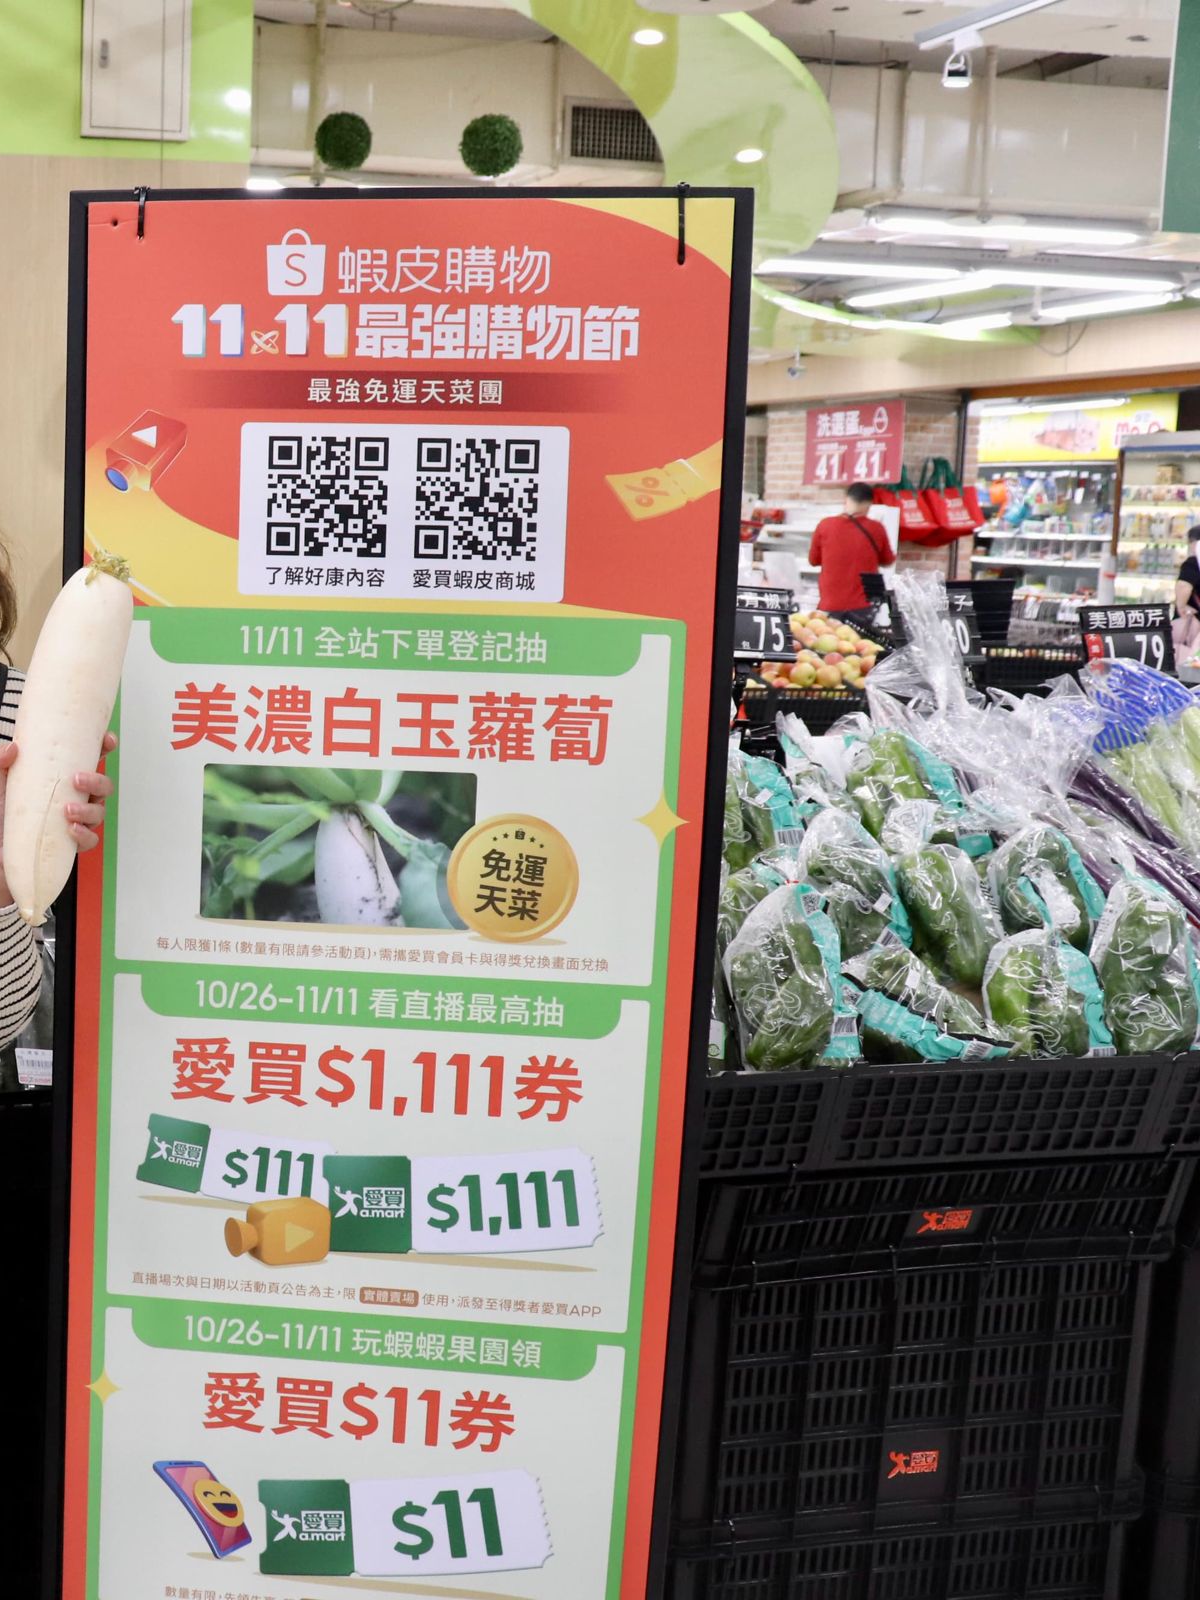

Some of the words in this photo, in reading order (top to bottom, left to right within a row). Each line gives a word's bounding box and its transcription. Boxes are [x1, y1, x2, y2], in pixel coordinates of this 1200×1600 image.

[338, 245, 552, 295] 蝦皮購物
[307, 377, 504, 405] 最強免運天菜團
[815, 451, 840, 481] 41
[854, 451, 882, 480] 41
[265, 565, 386, 589] 了解好康內容
[412, 567, 535, 592] 愛買蝦皮商城
[753, 615, 785, 652] 75
[1088, 608, 1166, 630] 美國西芹
[240, 625, 304, 656] 11/11
[314, 627, 547, 664] 全站下單登記抽
[1134, 634, 1165, 672] 79
[171, 681, 613, 766] 美濃白玉蘿蔔
[480, 848, 548, 888] 免運
[474, 884, 542, 922] 天菜
[195, 980, 358, 1015] 10/26-11/11
[368, 988, 564, 1028] 看直播最高抽
[171, 1037, 583, 1122] 愛買$1,111券
[168, 1155, 201, 1168] a.mart
[173, 1141, 202, 1161] 愛買
[222, 1146, 315, 1198] $111
[360, 1208, 406, 1219] a.mart
[364, 1187, 405, 1209] 愛買
[427, 1168, 581, 1236] $1,111
[184, 1314, 343, 1353] 10/26-11/11
[352, 1331, 542, 1370] 玩蝦蝦果園領
[203, 1371, 516, 1453] 愛買$11券
[299, 1531, 346, 1542] a.mart
[302, 1511, 345, 1531] 愛買
[391, 1487, 504, 1561] $11
